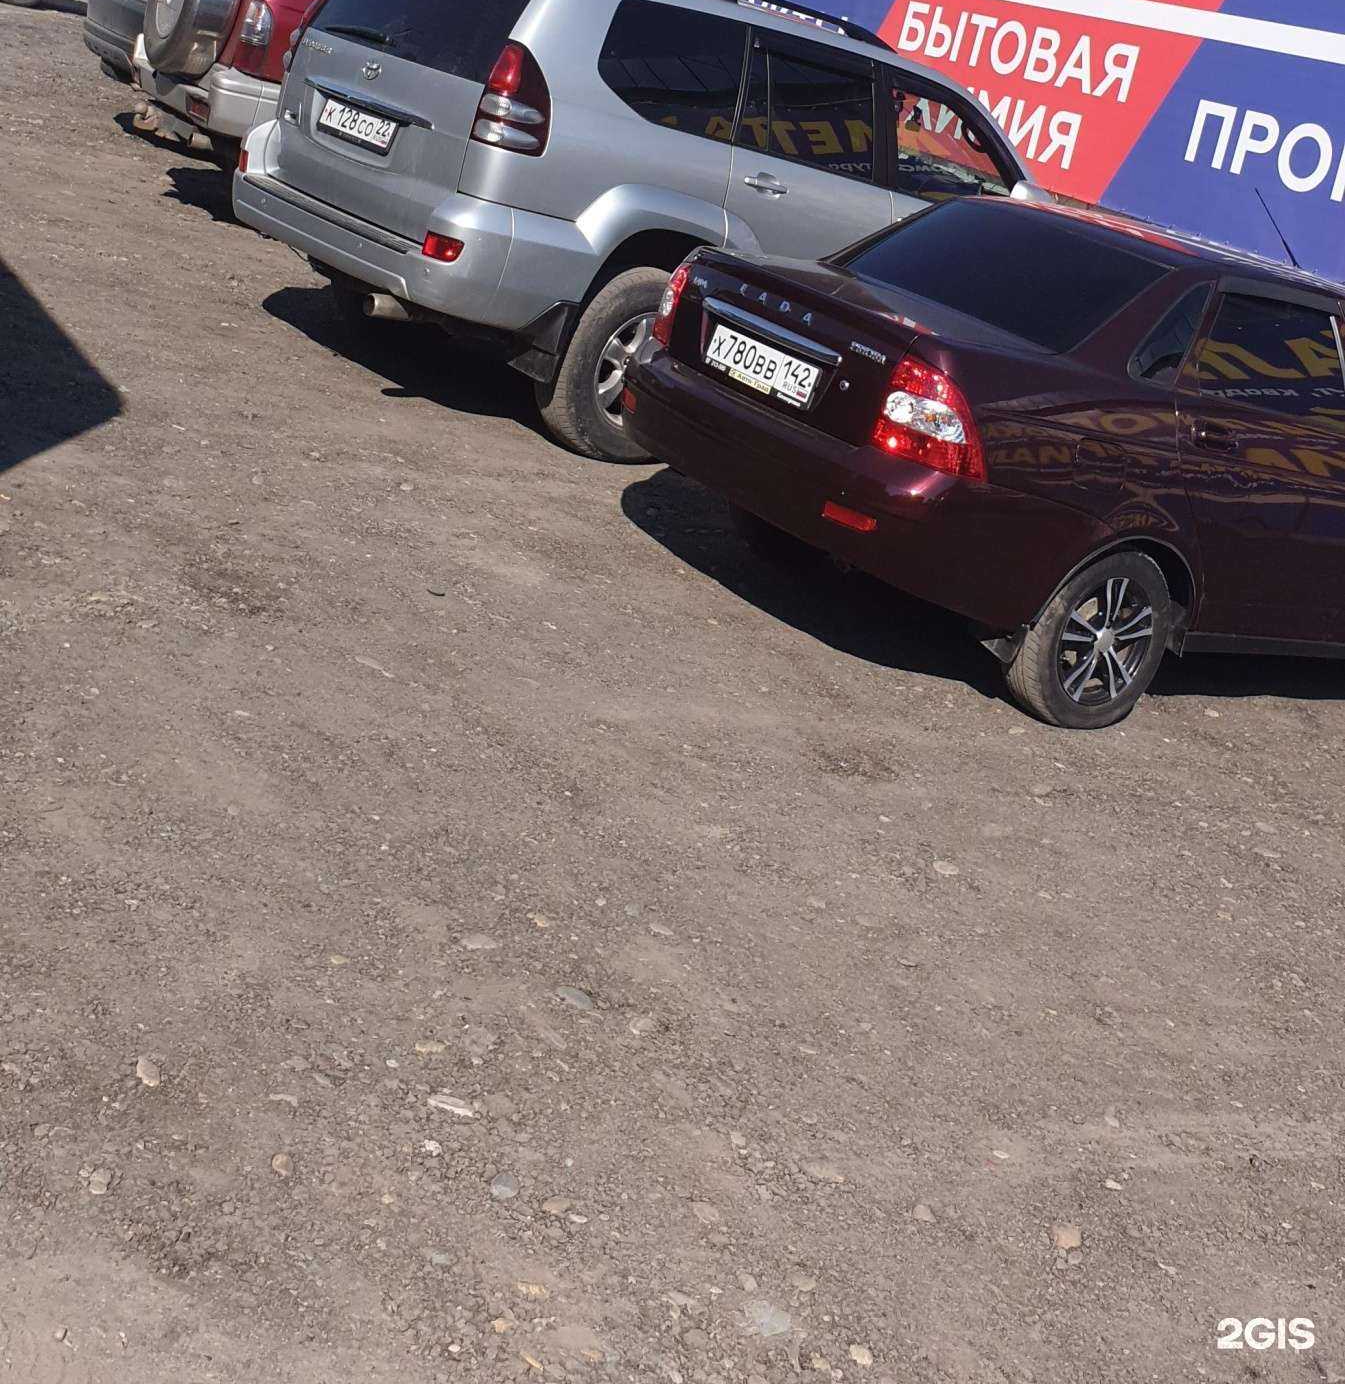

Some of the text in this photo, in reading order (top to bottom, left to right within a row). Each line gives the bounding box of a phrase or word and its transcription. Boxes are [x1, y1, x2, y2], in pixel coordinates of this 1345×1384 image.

[897, 0, 1140, 104] БЫТОВАЯ
[1183, 98, 1345, 203] ПРО
[783, 360, 811, 389] 142
